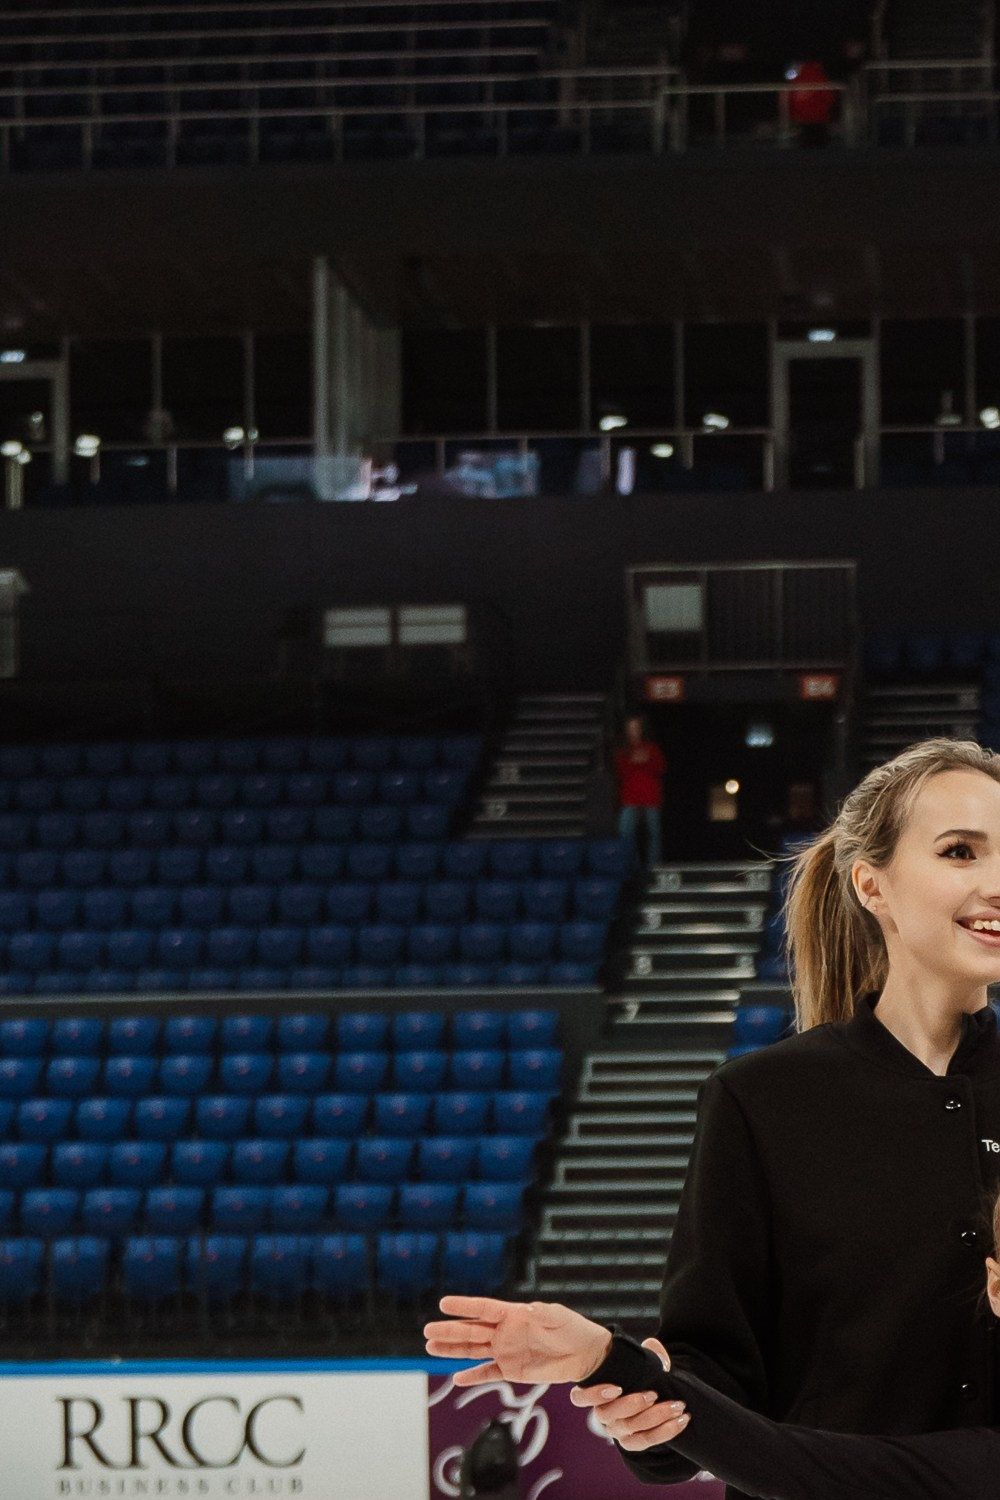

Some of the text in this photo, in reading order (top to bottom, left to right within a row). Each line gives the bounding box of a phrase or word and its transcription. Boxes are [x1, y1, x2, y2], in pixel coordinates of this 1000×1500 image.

[54, 1394, 307, 1471] RRCC
[57, 1476, 305, 1496] BUSINESS CLUB
